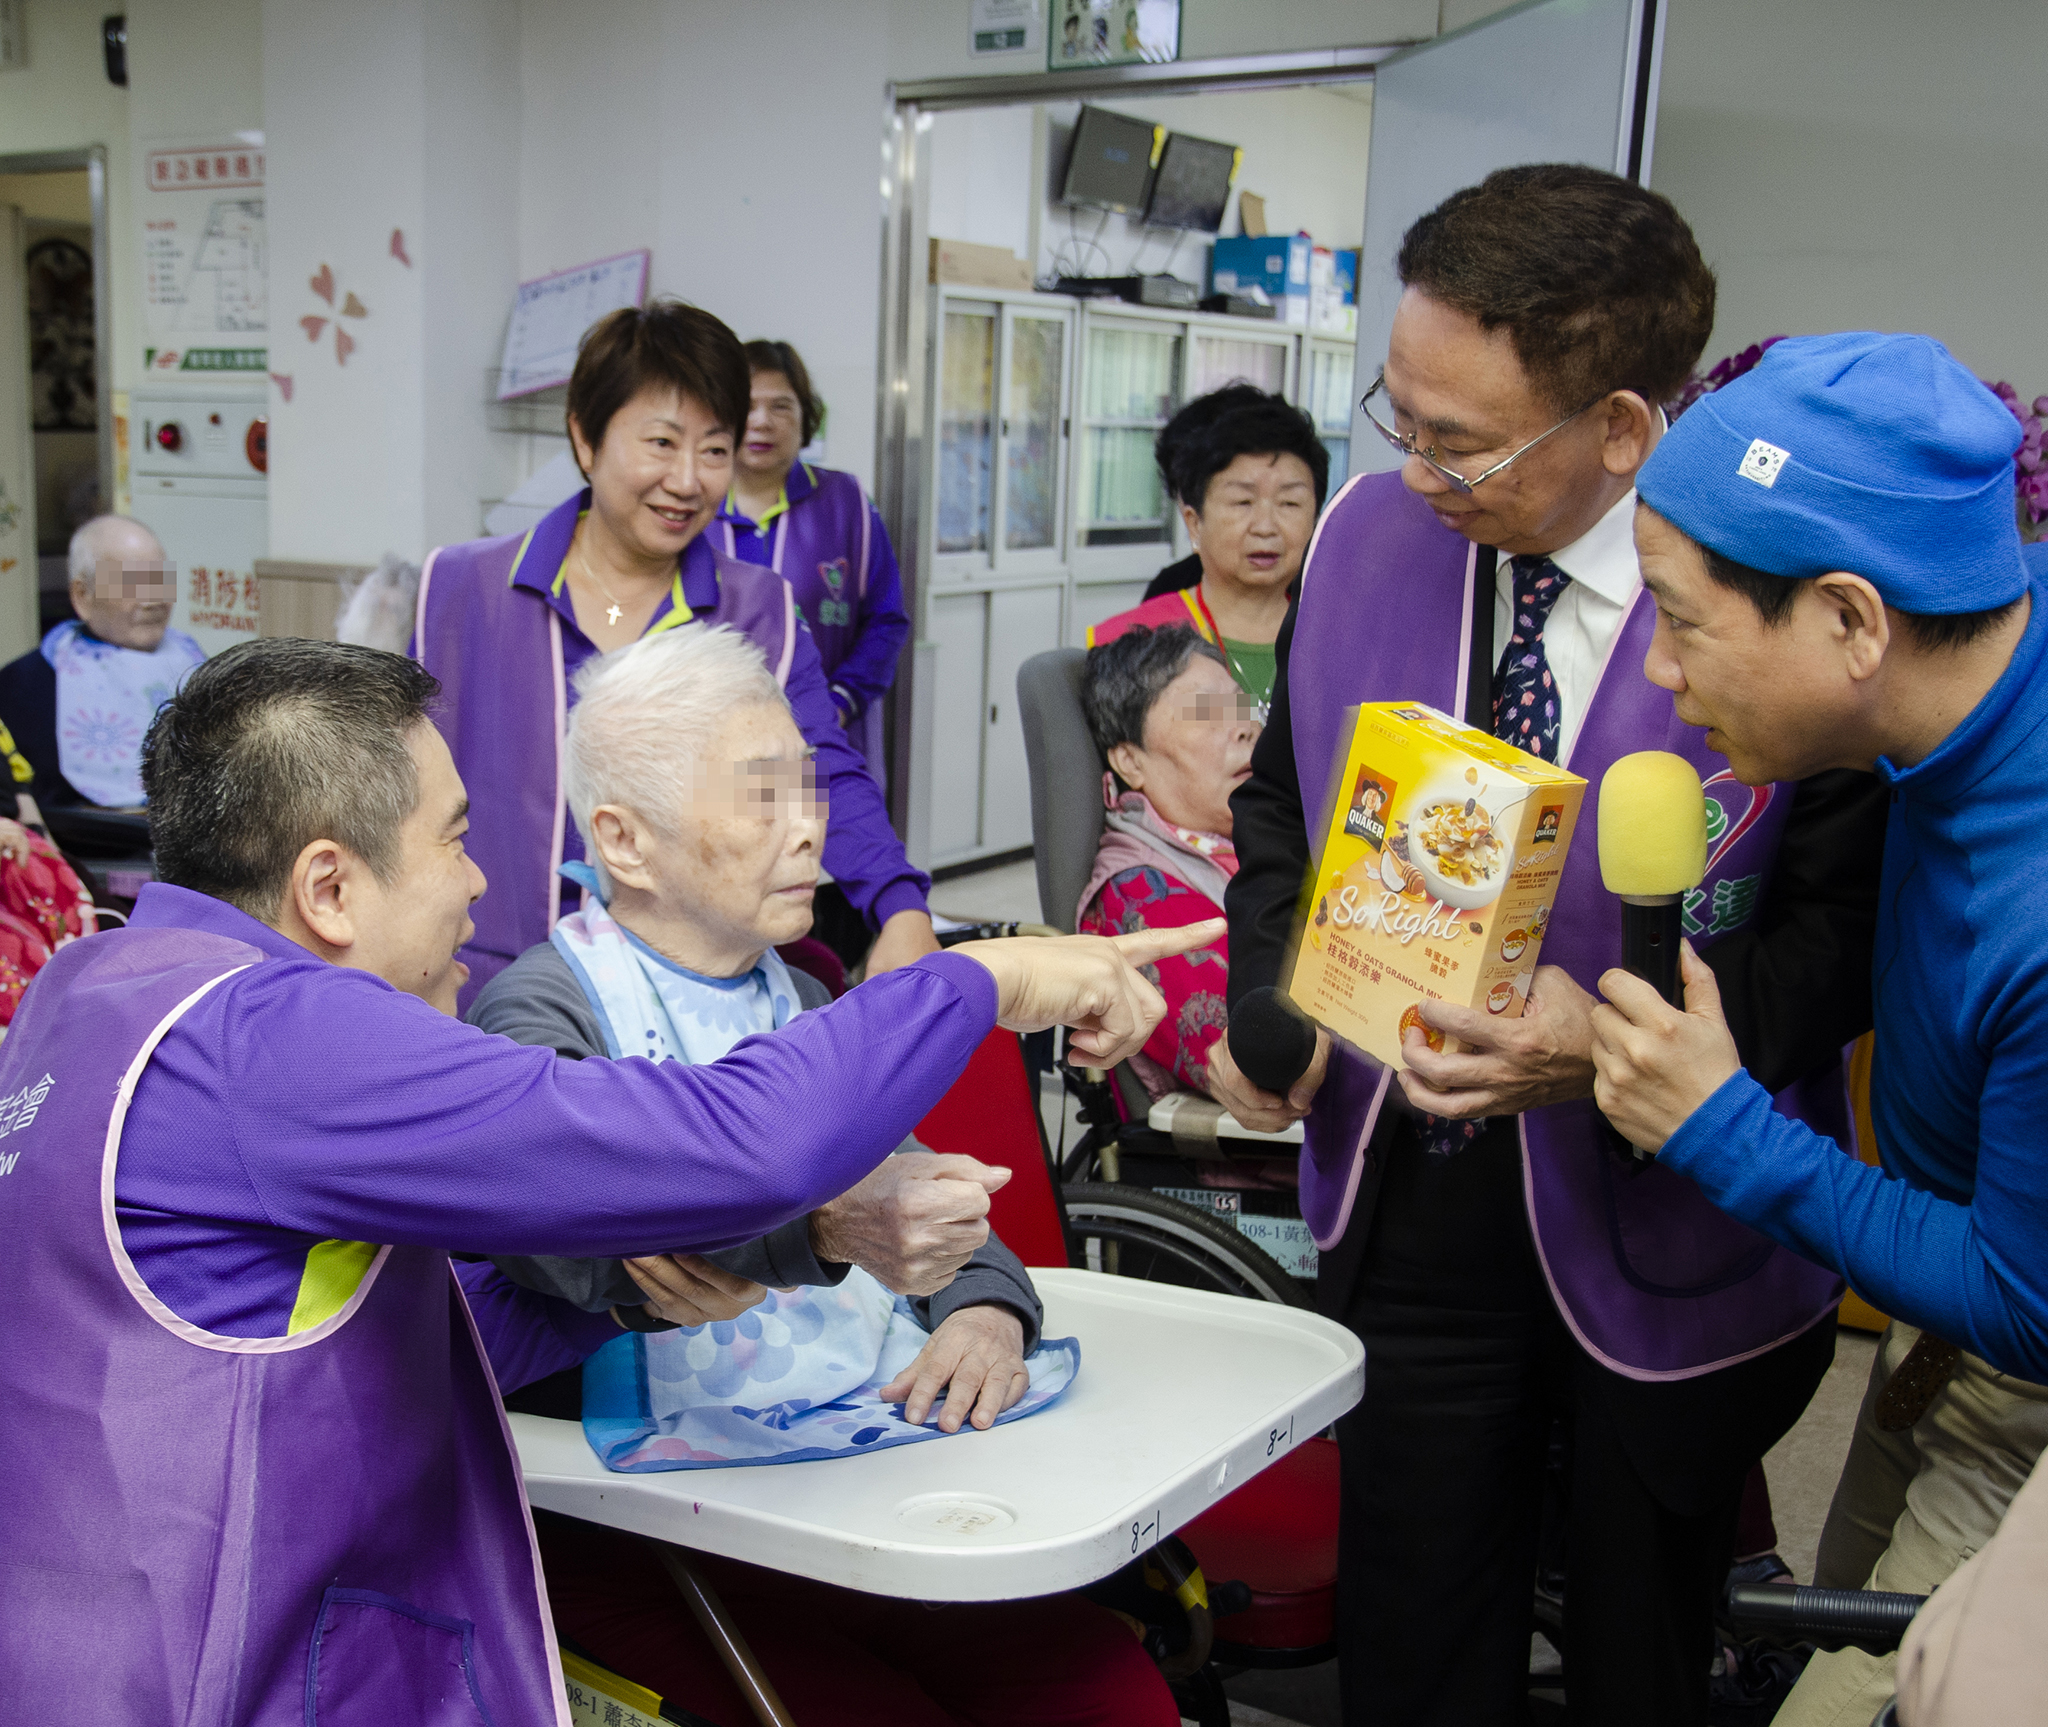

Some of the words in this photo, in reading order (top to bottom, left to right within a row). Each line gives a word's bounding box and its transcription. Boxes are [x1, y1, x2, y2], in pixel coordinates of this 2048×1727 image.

[1751, 446, 1779, 465] BEAMS
[1348, 808, 1385, 840] QUAKER
[1535, 828, 1557, 838] QUAKER
[1327, 942, 1381, 985] 桂格穀添樂
[1330, 931, 1355, 952] HONEY
[1356, 948, 1362, 957] &
[1364, 953, 1384, 970] OATS
[1385, 966, 1424, 993] GRANOLA
[1266, 1415, 1293, 1456] 8-1
[1131, 1510, 1160, 1554] 8-1
